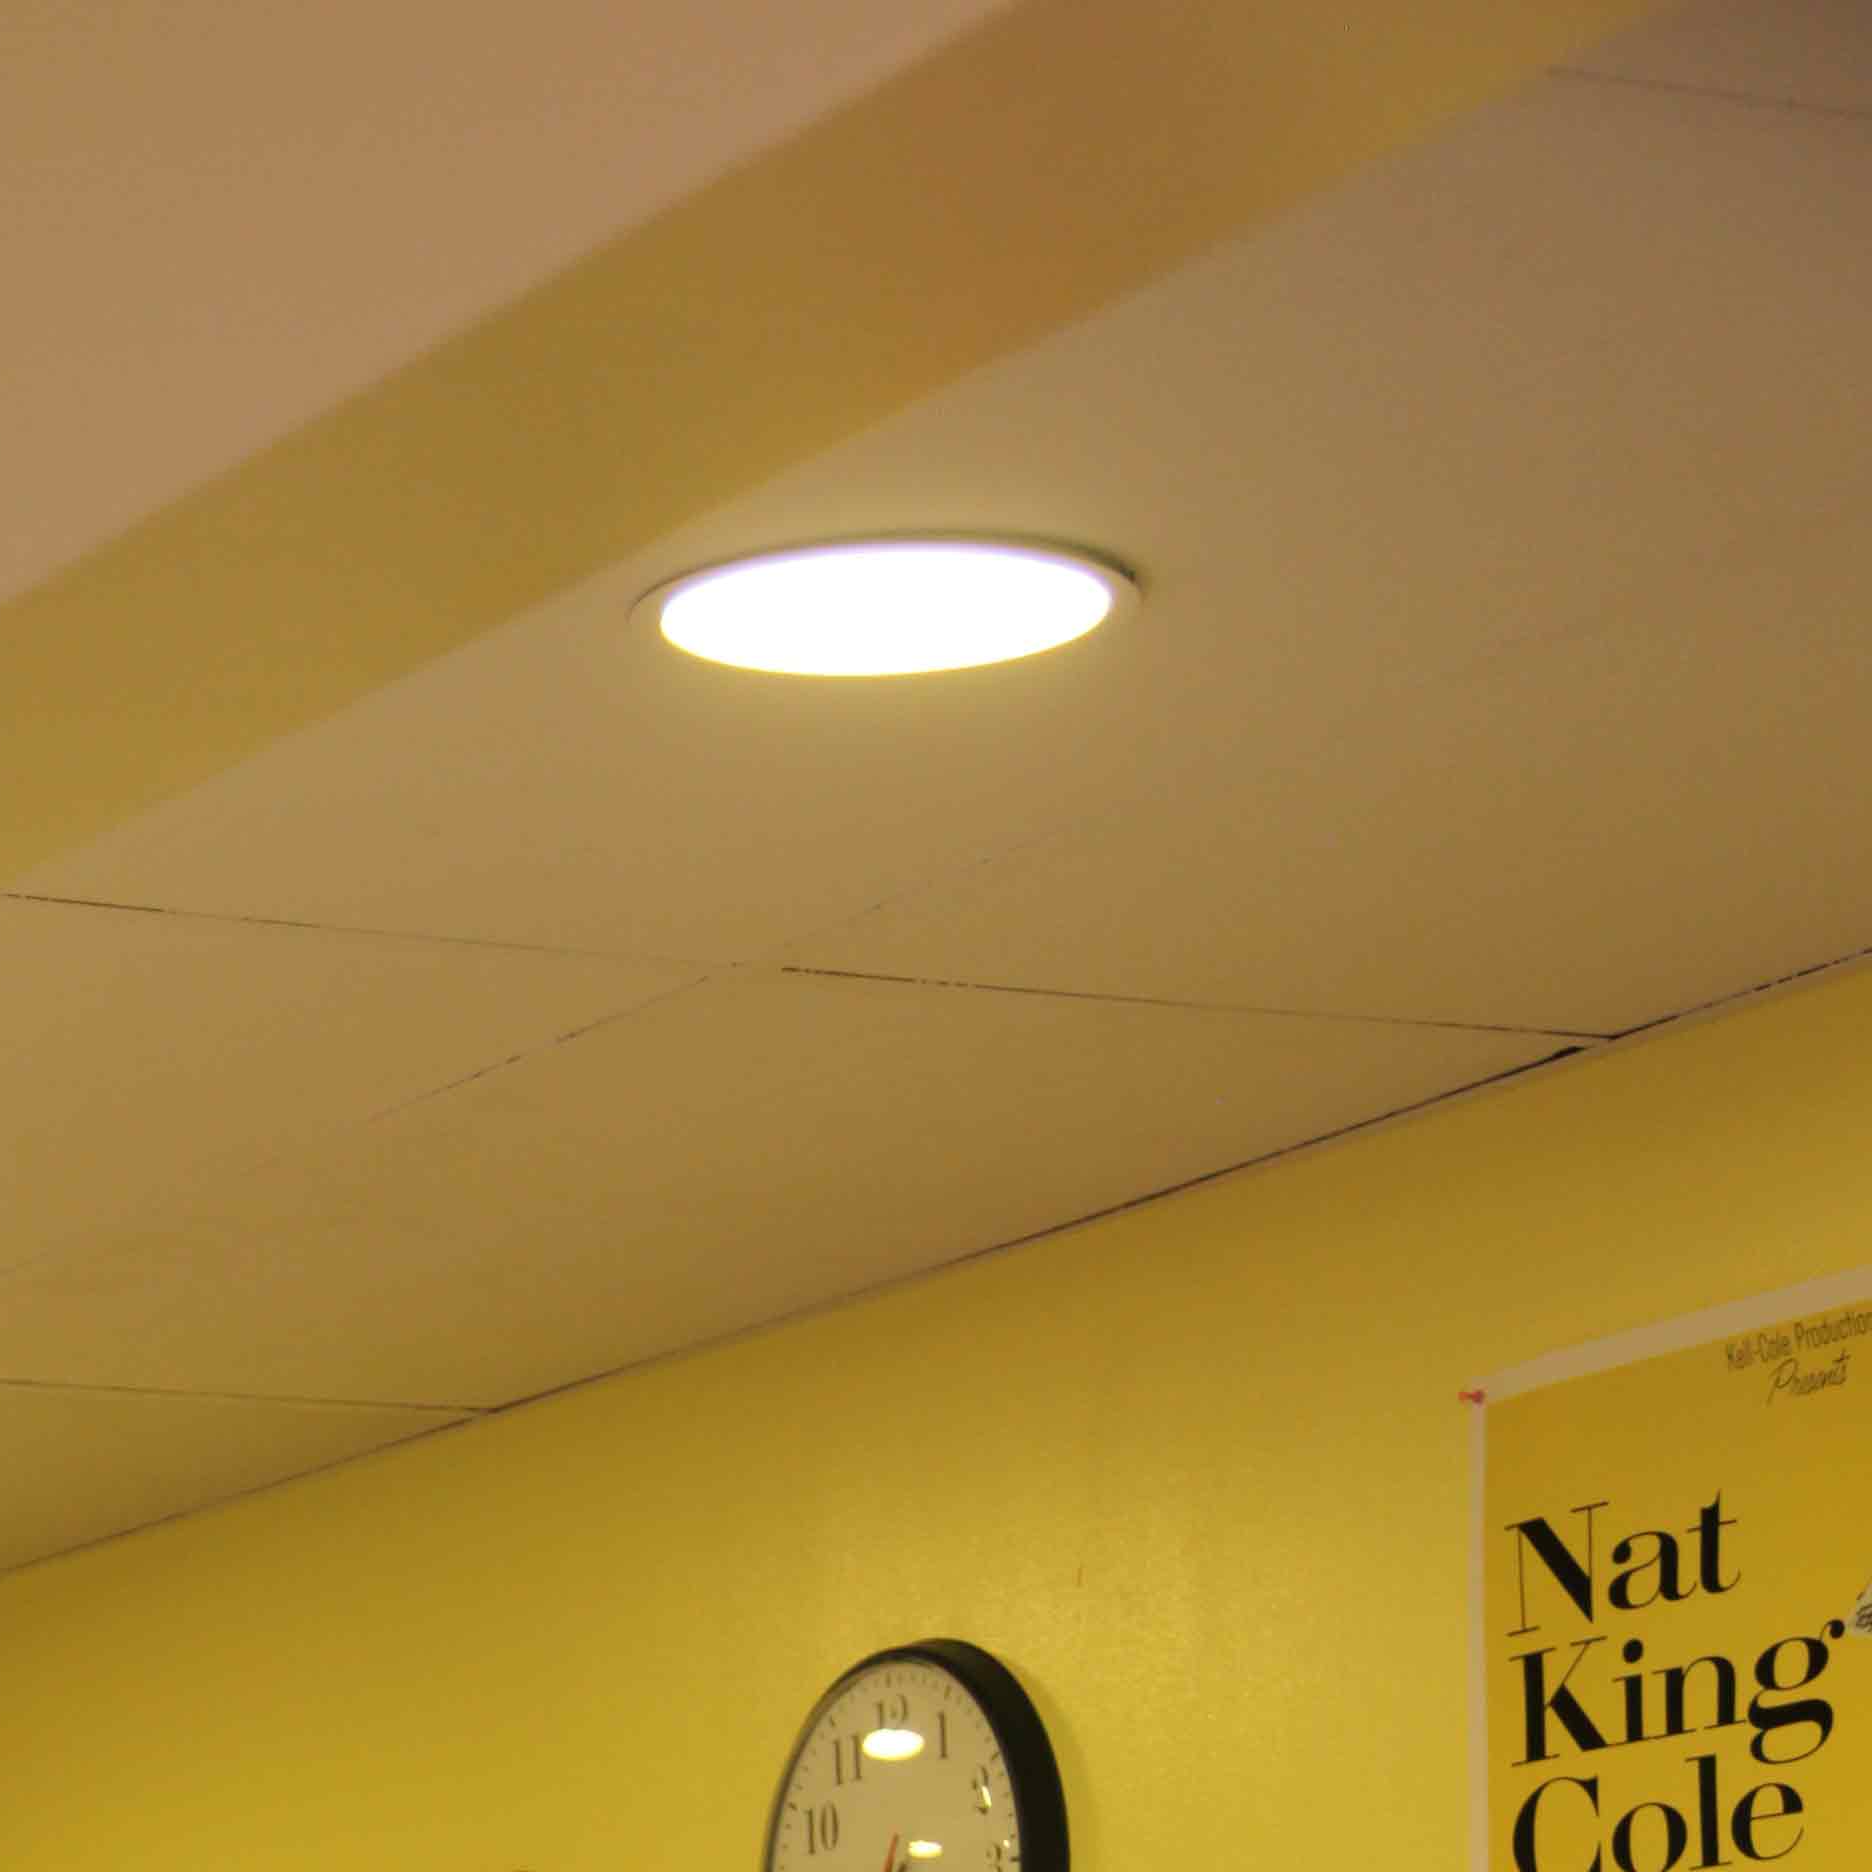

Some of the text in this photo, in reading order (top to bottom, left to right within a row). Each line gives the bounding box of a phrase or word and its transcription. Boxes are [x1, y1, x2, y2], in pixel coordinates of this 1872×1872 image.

[1766, 1350, 1851, 1406] Presents
[1504, 1488, 1741, 1637] Nat
[1509, 1618, 1845, 1767] King
[833, 1732, 863, 1786] 11
[806, 1800, 839, 1856] 10
